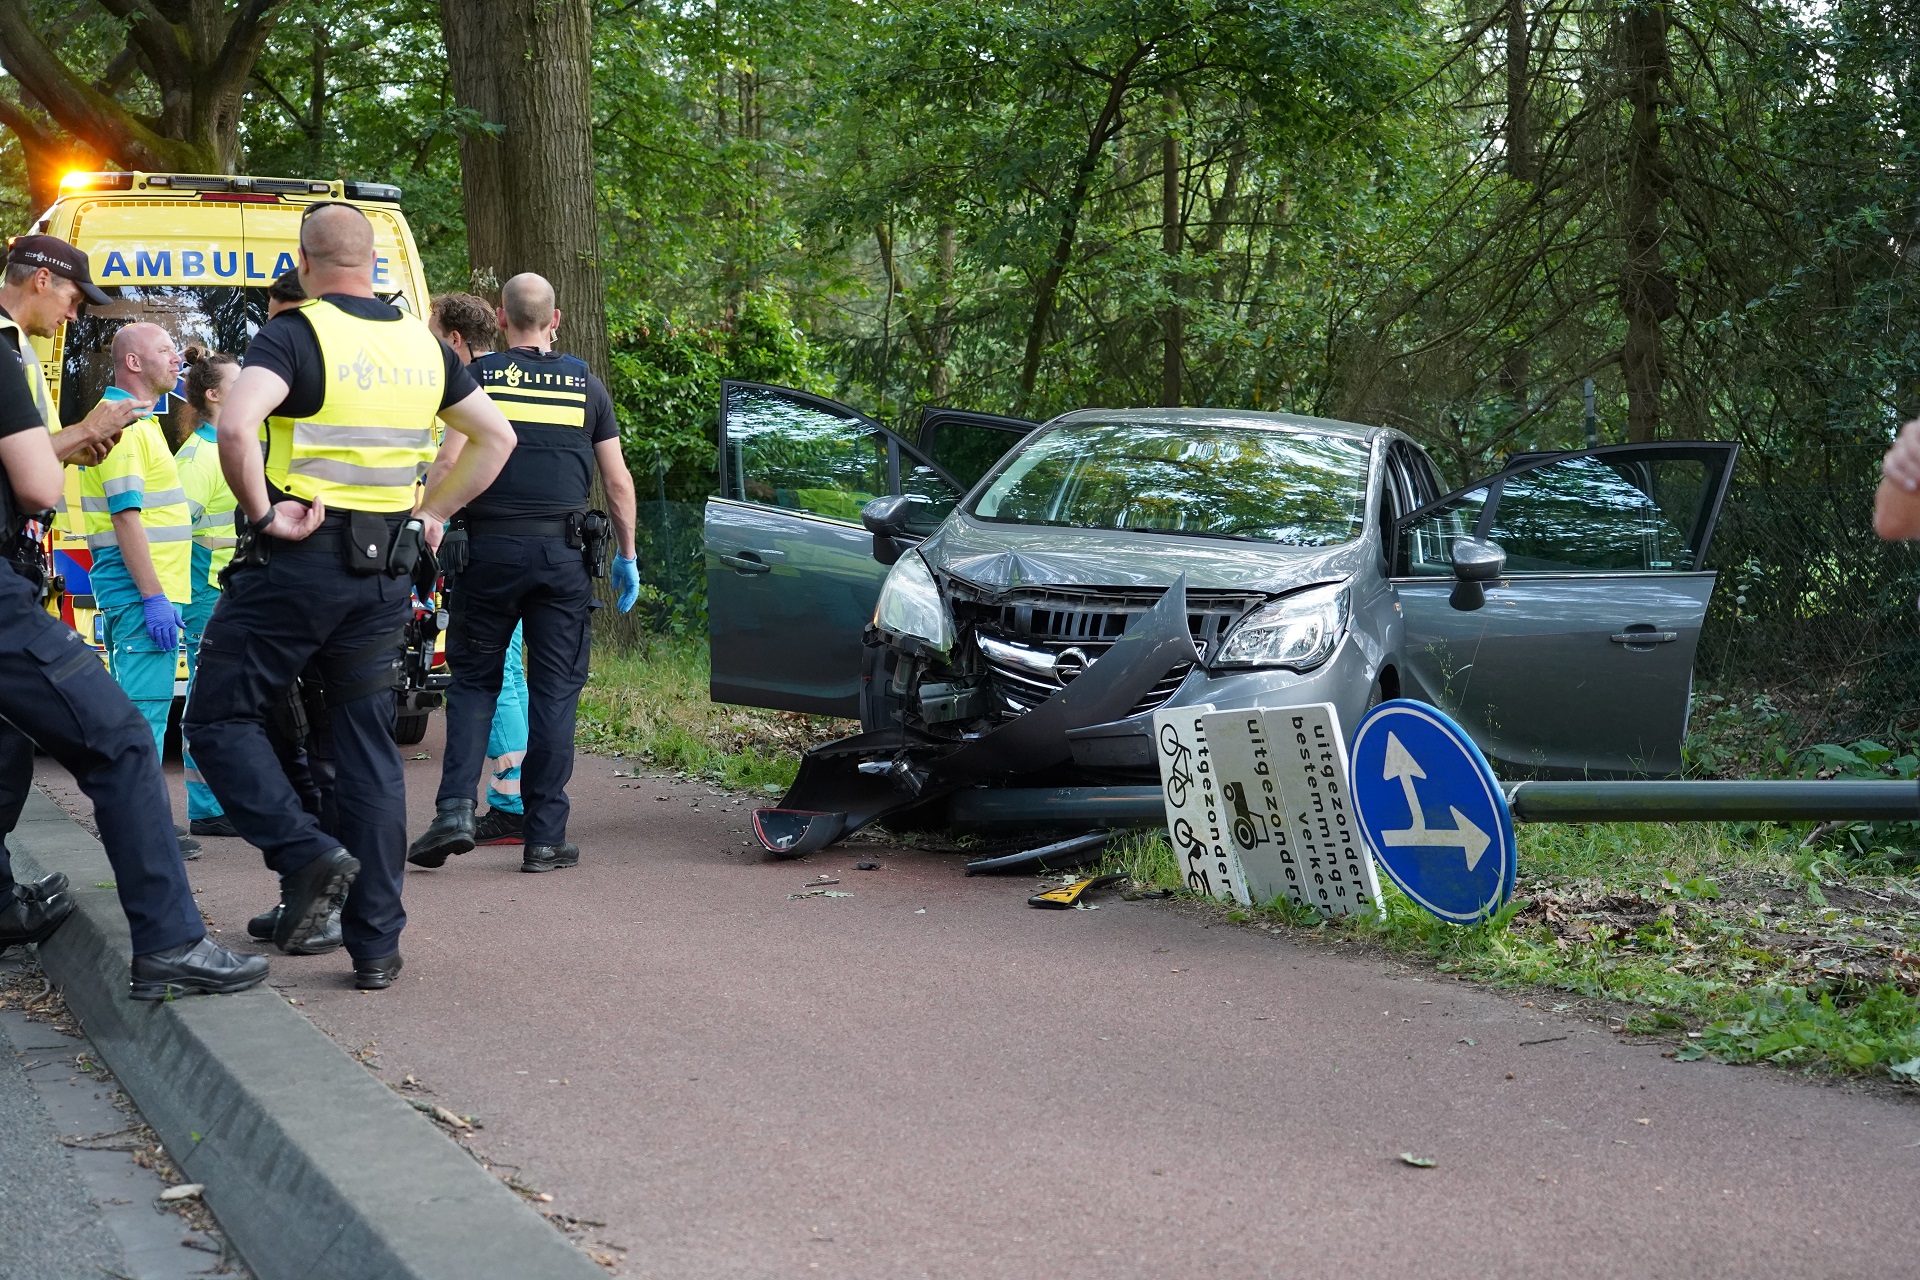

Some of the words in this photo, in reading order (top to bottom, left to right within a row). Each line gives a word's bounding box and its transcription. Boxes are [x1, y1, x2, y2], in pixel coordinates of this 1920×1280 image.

[33, 252, 65, 267] POLITIE
[101, 250, 390, 284] AMBULAE
[338, 350, 437, 390] POLITIE
[494, 362, 574, 387] POLITIE
[1292, 716, 1348, 915] bestemmings-
[1314, 725, 1370, 905] uitgezonderd
[1298, 812, 1332, 914] verkeer
